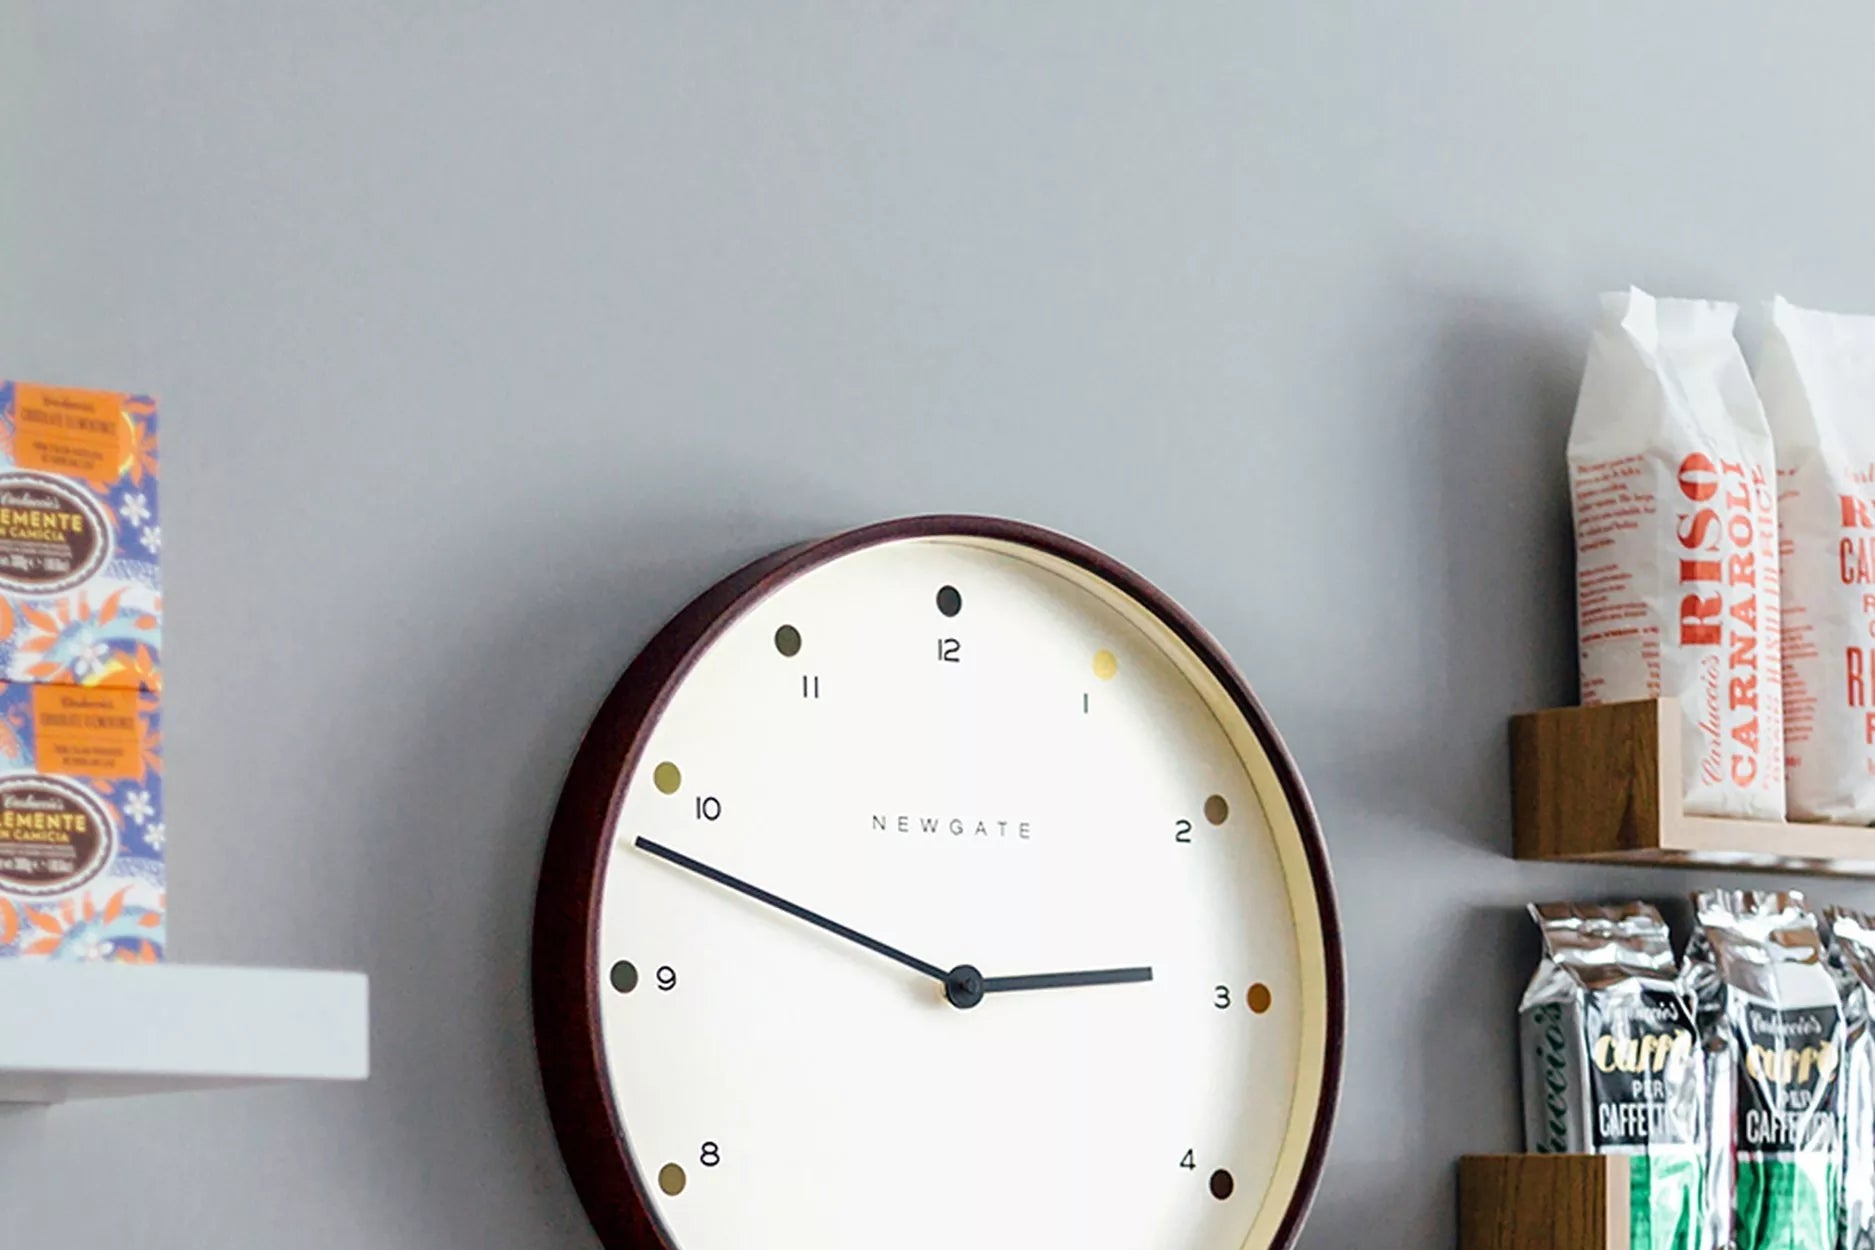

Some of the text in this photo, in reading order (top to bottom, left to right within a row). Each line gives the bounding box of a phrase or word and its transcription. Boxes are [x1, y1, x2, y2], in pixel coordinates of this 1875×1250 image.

[0, 508, 83, 532] EMENTE
[1677, 452, 1722, 646] RISO
[1720, 458, 1759, 789] CARNAROLI
[937, 637, 961, 663] 12
[802, 675, 819, 699] 11
[1699, 655, 1722, 786] Carluccio's
[0, 810, 86, 833] EMENTE
[695, 796, 722, 822] 10
[872, 814, 1030, 840] NEWGATE
[1175, 819, 1193, 844] 2
[655, 965, 677, 992] 9
[1214, 984, 1232, 1010] 3
[1535, 1002, 1568, 1154] uccio's
[699, 1140, 721, 1168] 8
[1179, 1148, 1197, 1171] 4
